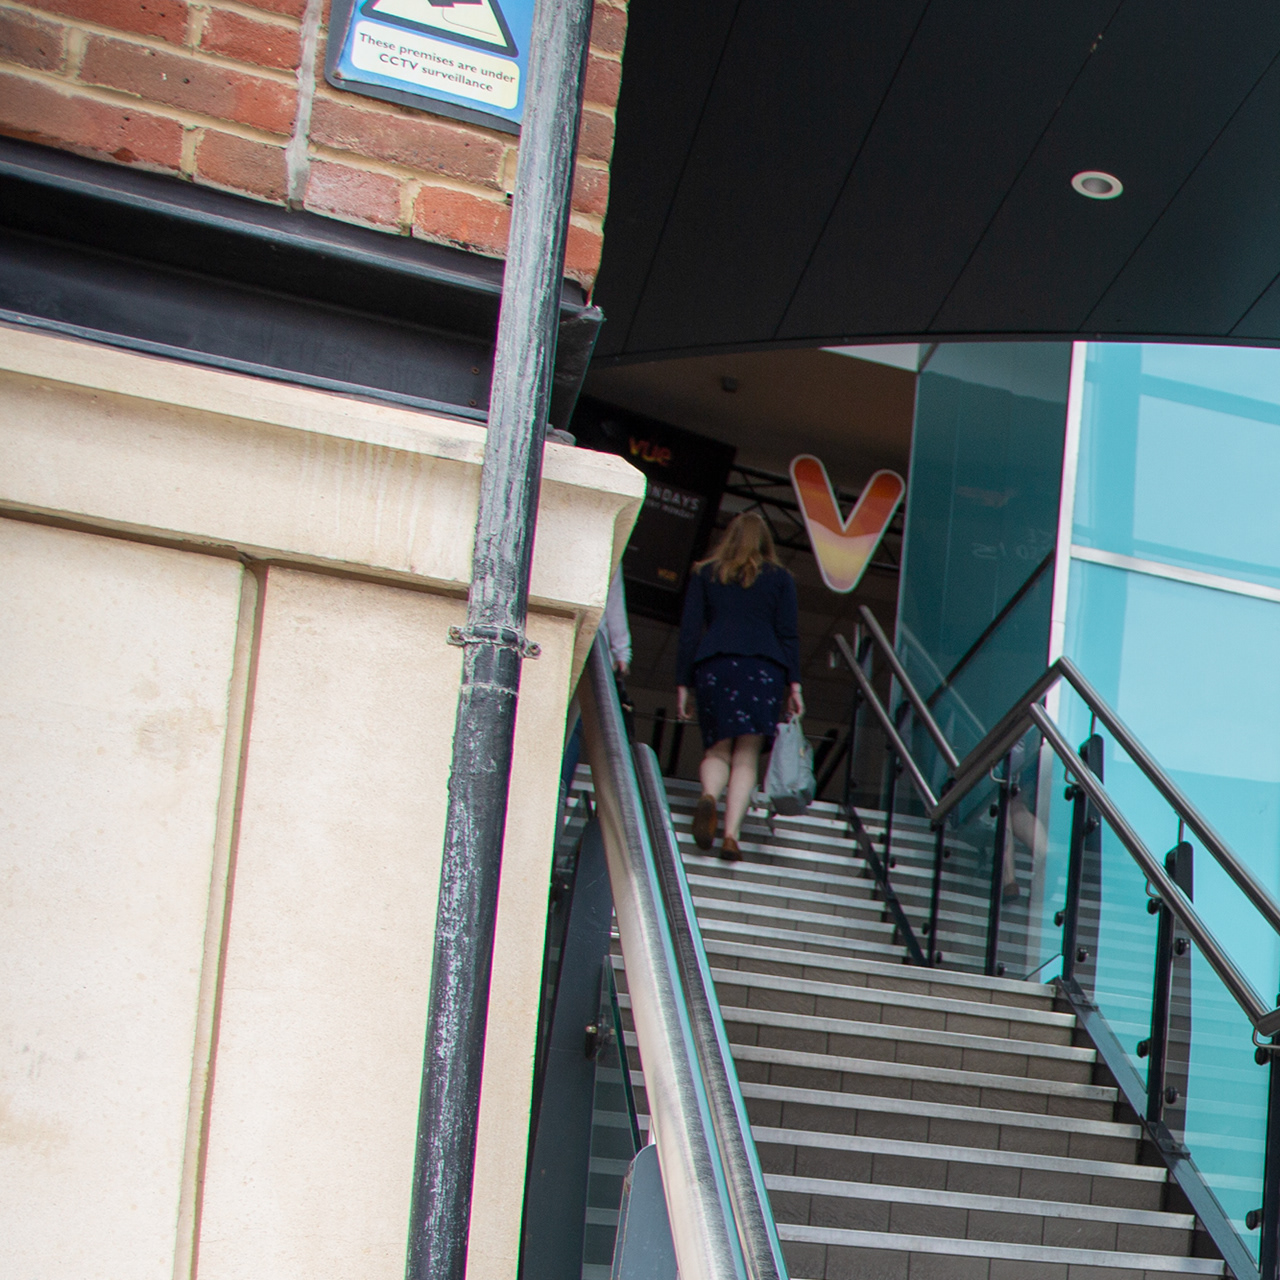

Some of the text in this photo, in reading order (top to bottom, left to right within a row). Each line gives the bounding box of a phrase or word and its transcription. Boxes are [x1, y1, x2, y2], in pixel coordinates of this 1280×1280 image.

[359, 31, 516, 84] These premises are under
[379, 53, 493, 92] CCTV surveillance
